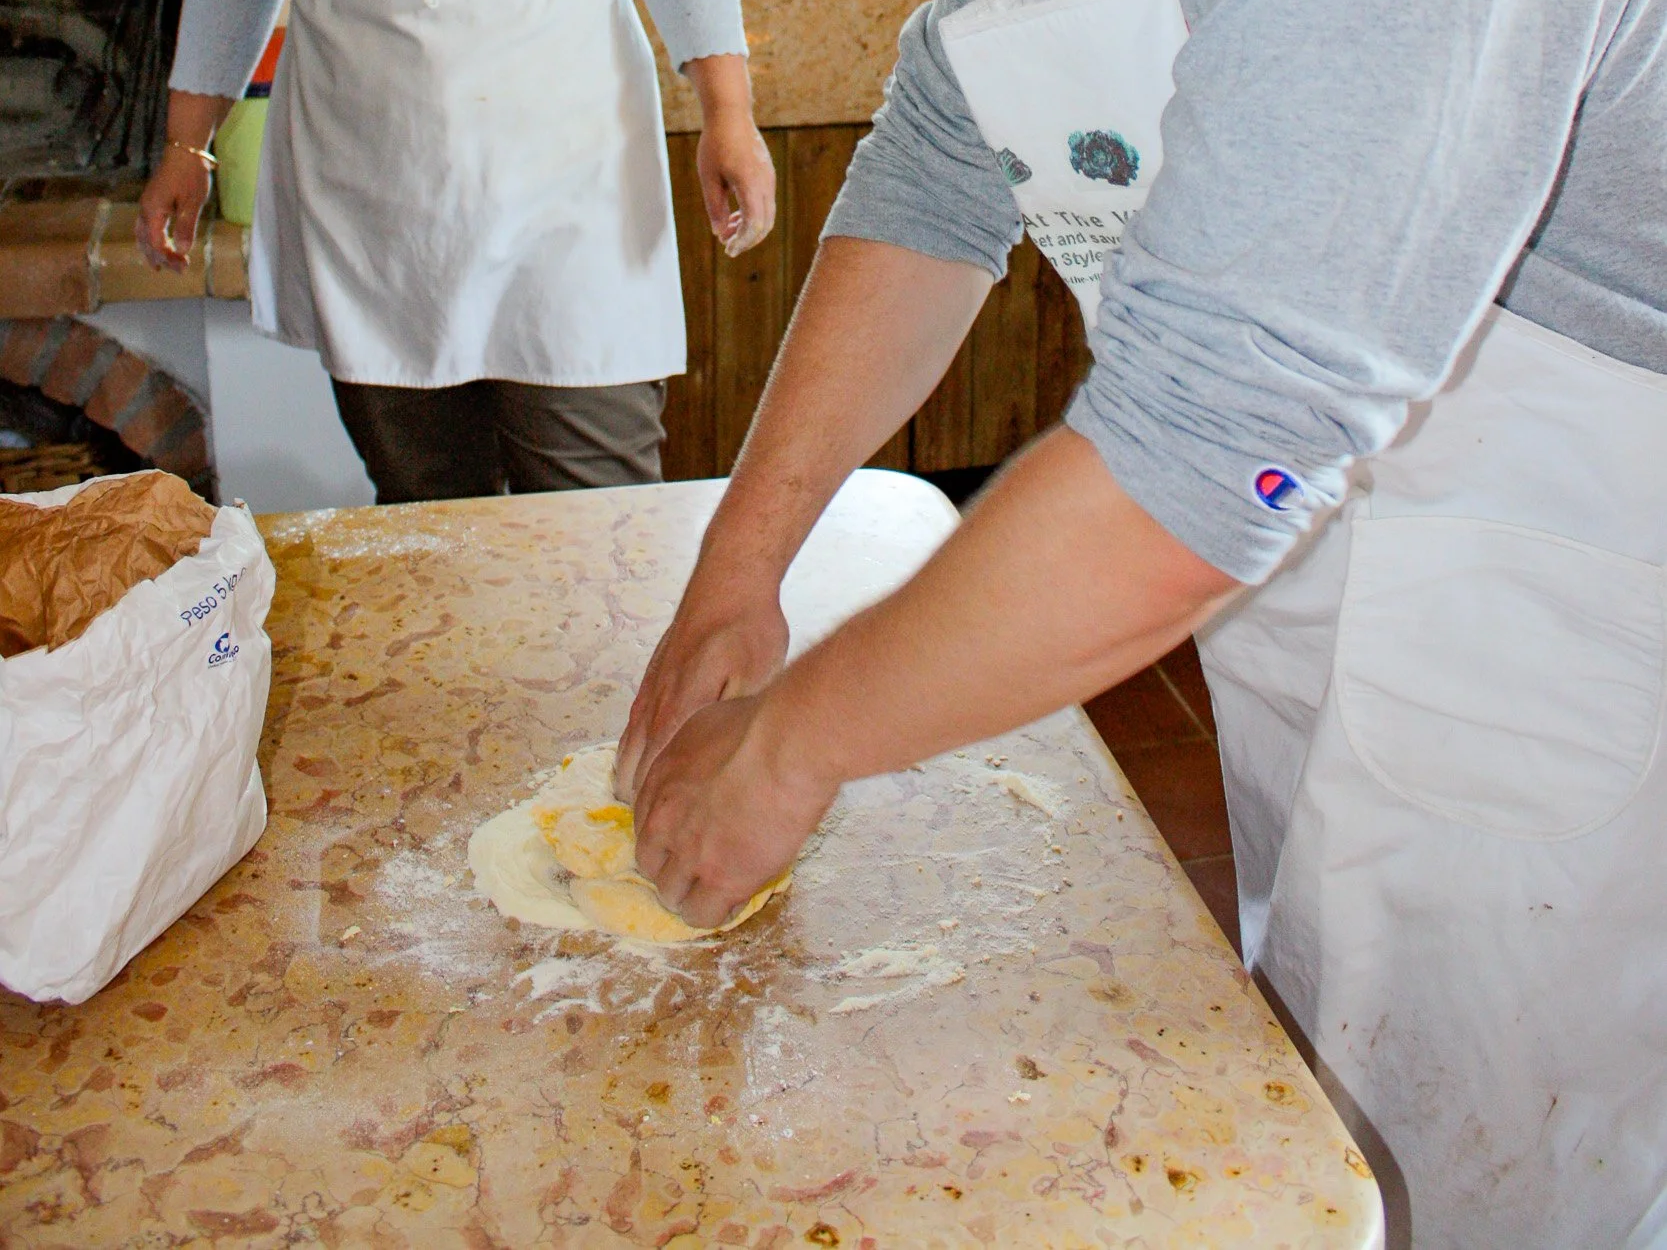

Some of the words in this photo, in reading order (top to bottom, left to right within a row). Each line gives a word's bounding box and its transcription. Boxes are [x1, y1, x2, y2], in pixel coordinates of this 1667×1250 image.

[1054, 211, 1105, 227] The
[1058, 231, 1087, 247] and
[1061, 249, 1103, 268] Style
[180, 596, 218, 627] Peso
[213, 583, 227, 600] 5
